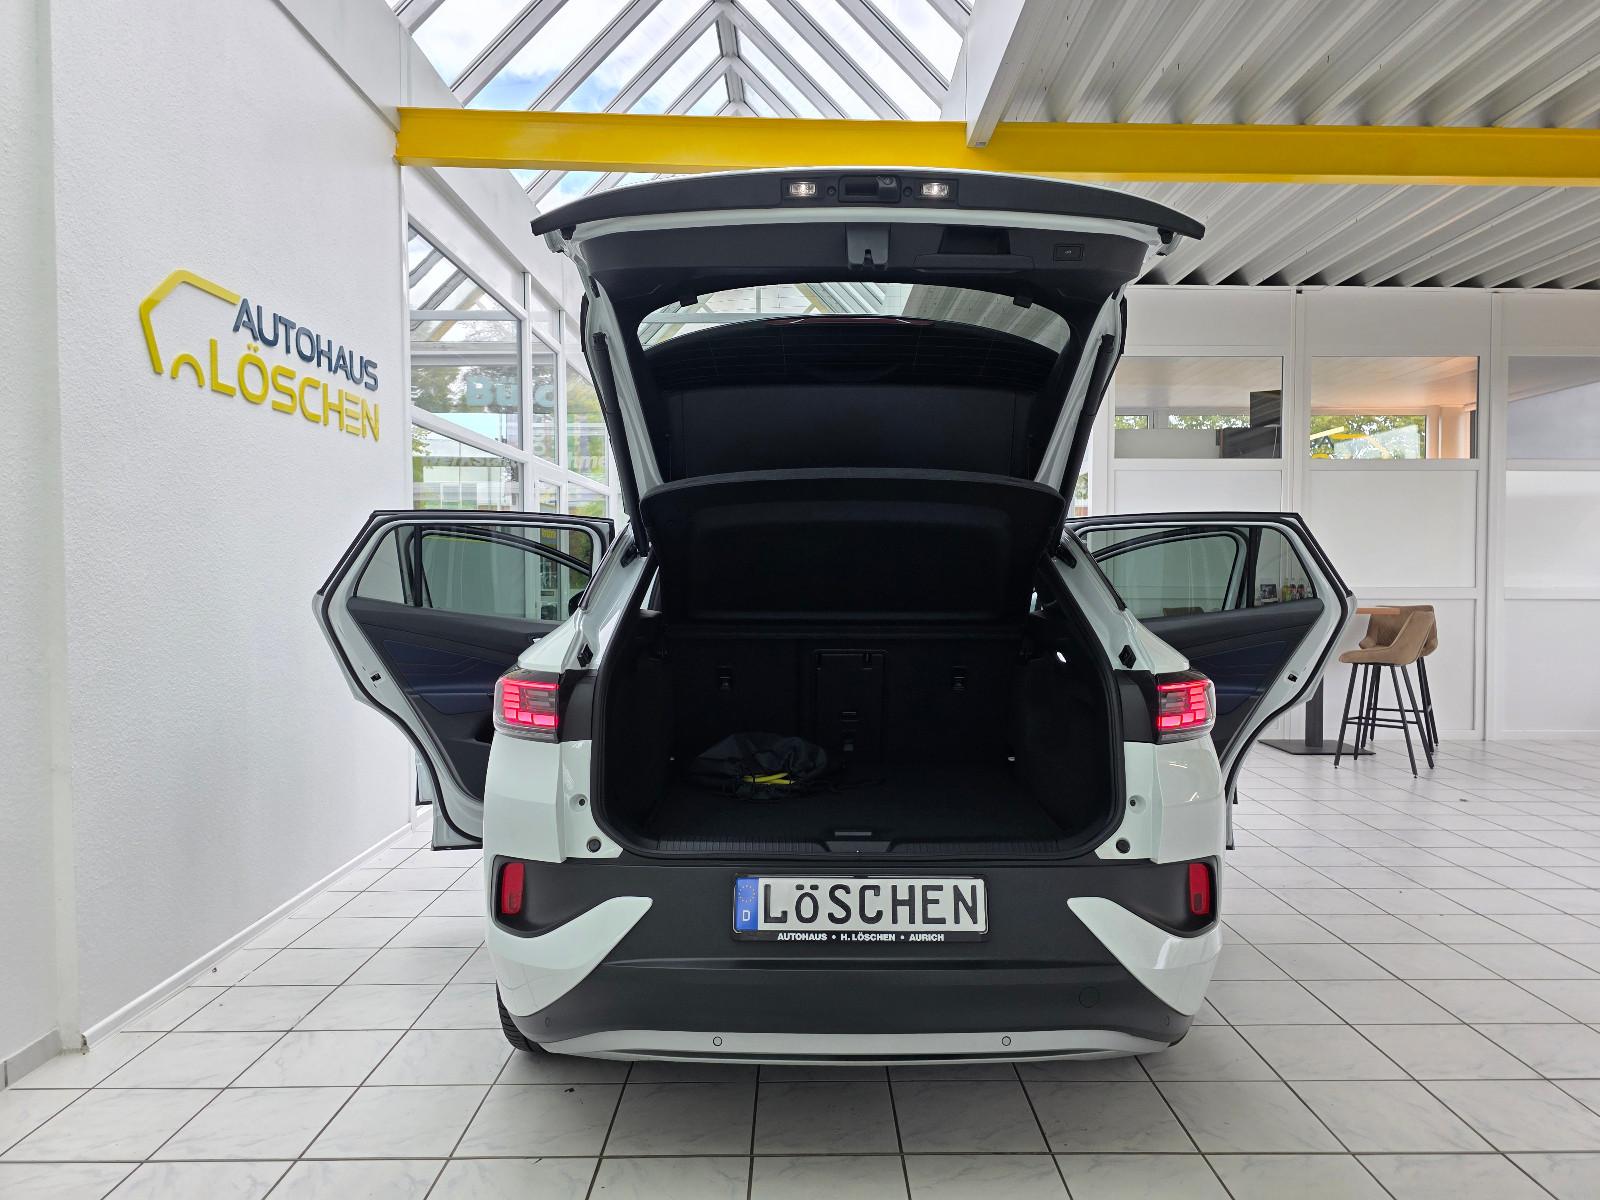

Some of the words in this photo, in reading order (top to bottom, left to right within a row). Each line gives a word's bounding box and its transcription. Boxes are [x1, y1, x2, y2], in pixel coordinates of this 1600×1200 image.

[233, 298, 378, 391] AUTOHAUS
[209, 338, 380, 442] LÖSCHEN
[742, 909, 751, 922] D
[777, 932, 828, 942] AUTOHAUS
[851, 931, 896, 942] LÖSCHEN
[908, 933, 945, 942] AURICH
